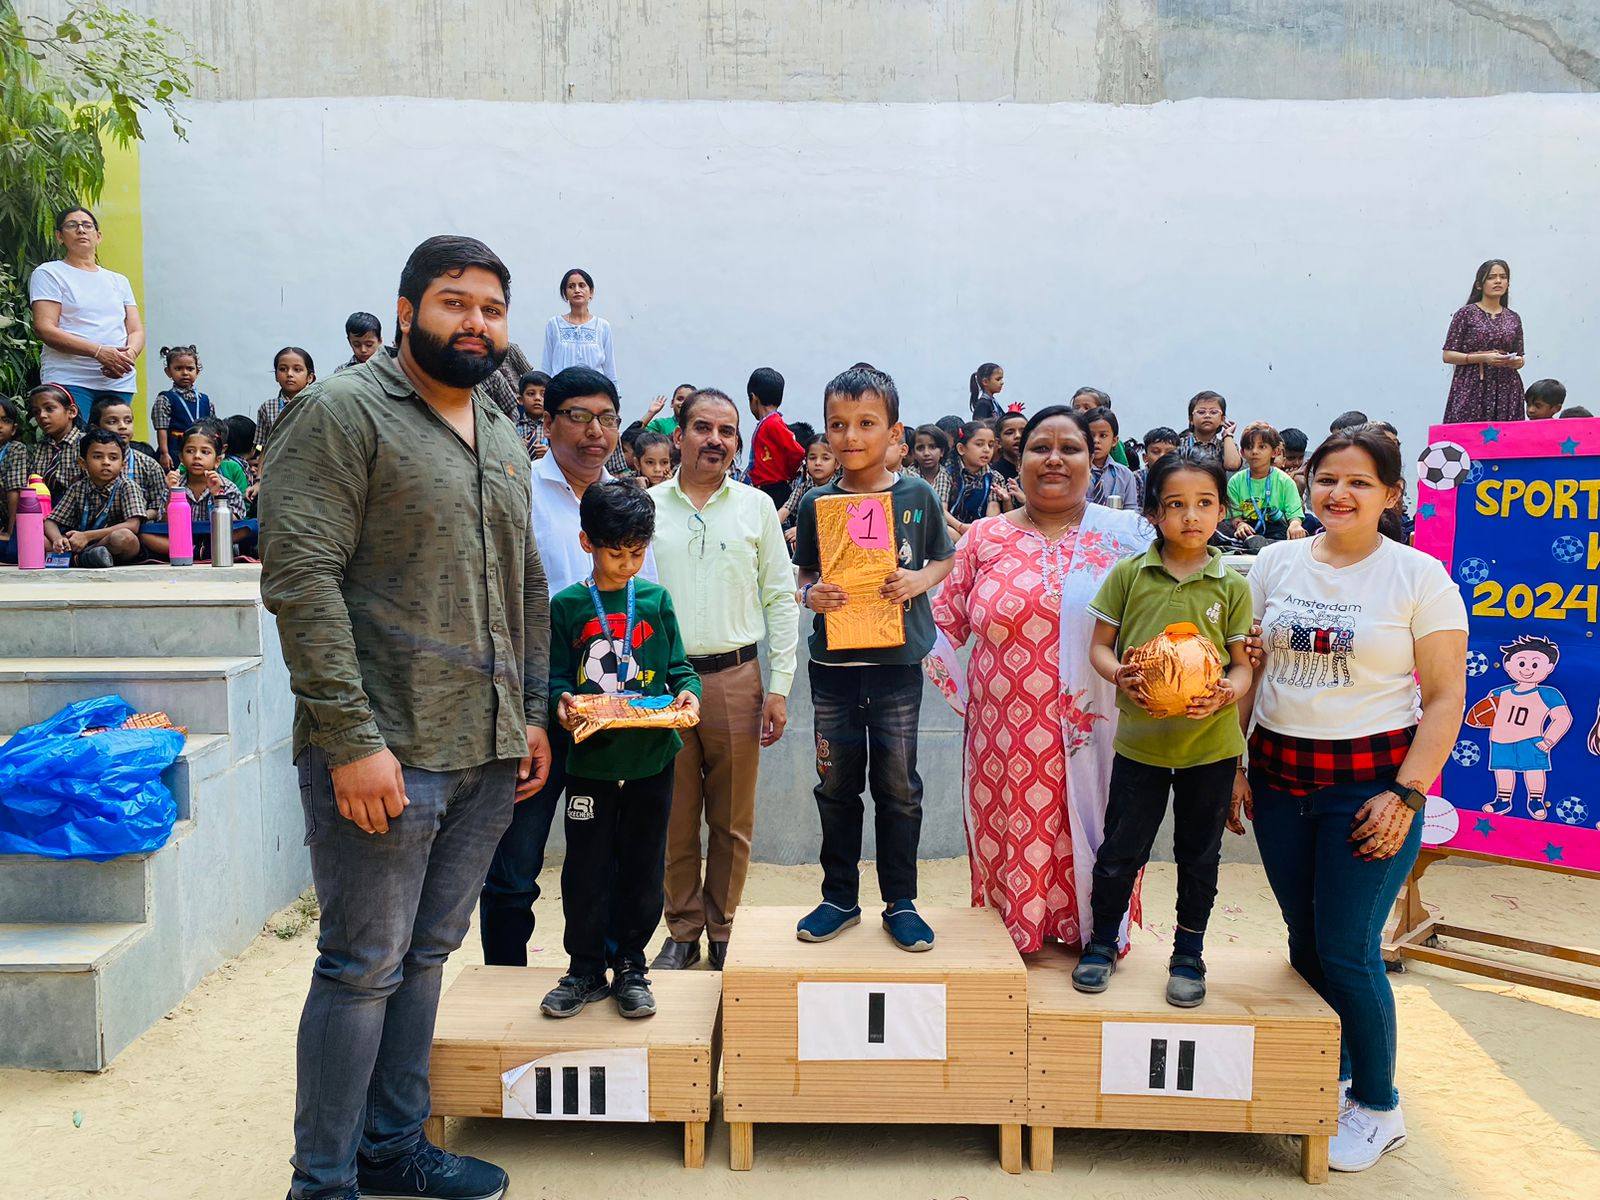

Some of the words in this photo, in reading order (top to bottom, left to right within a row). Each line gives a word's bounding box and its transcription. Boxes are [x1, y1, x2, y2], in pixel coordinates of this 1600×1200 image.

[1475, 479, 1600, 519] SPORT
[859, 508, 878, 539] 1
[1283, 594, 1362, 612] Amsterdam
[1472, 580, 1598, 622] 2024
[1507, 706, 1529, 726] 10
